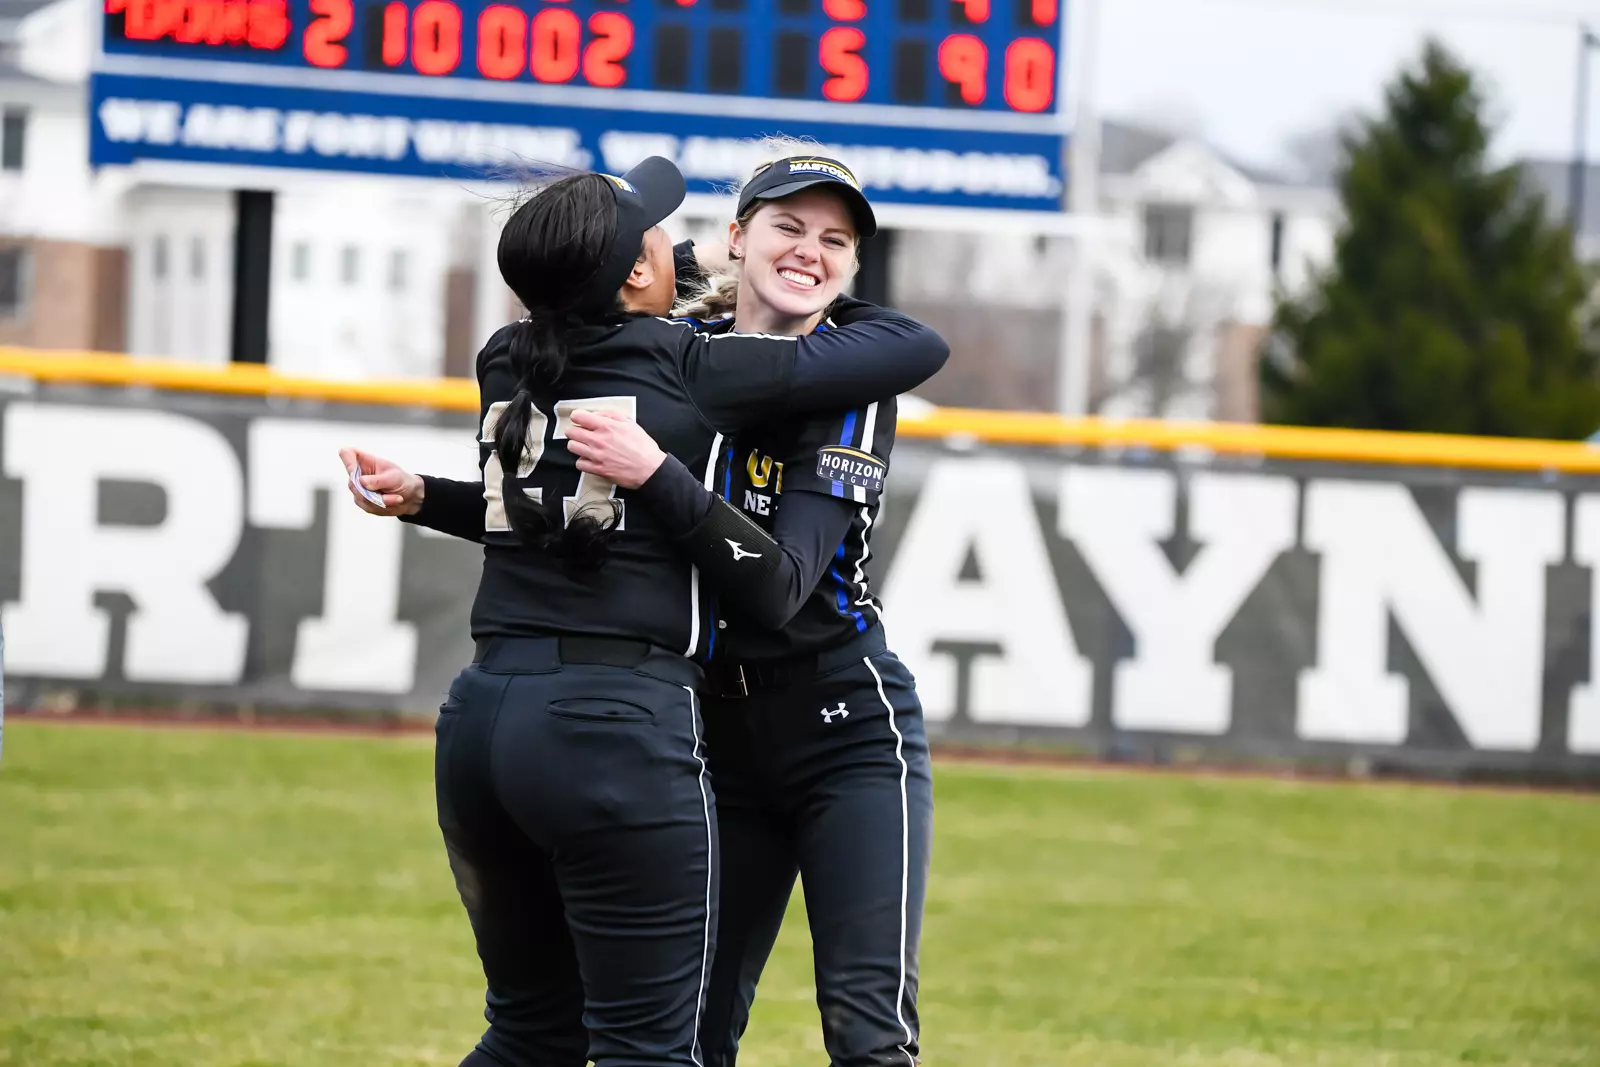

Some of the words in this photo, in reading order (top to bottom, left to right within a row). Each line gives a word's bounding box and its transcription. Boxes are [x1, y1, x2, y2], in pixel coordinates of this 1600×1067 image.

[819, 26, 869, 102] 5
[99, 97, 181, 144] WE
[283, 110, 408, 160] FORT
[819, 467, 881, 489] LEAGUE
[821, 453, 883, 480] HORIZON
[876, 458, 1600, 755] AYN
